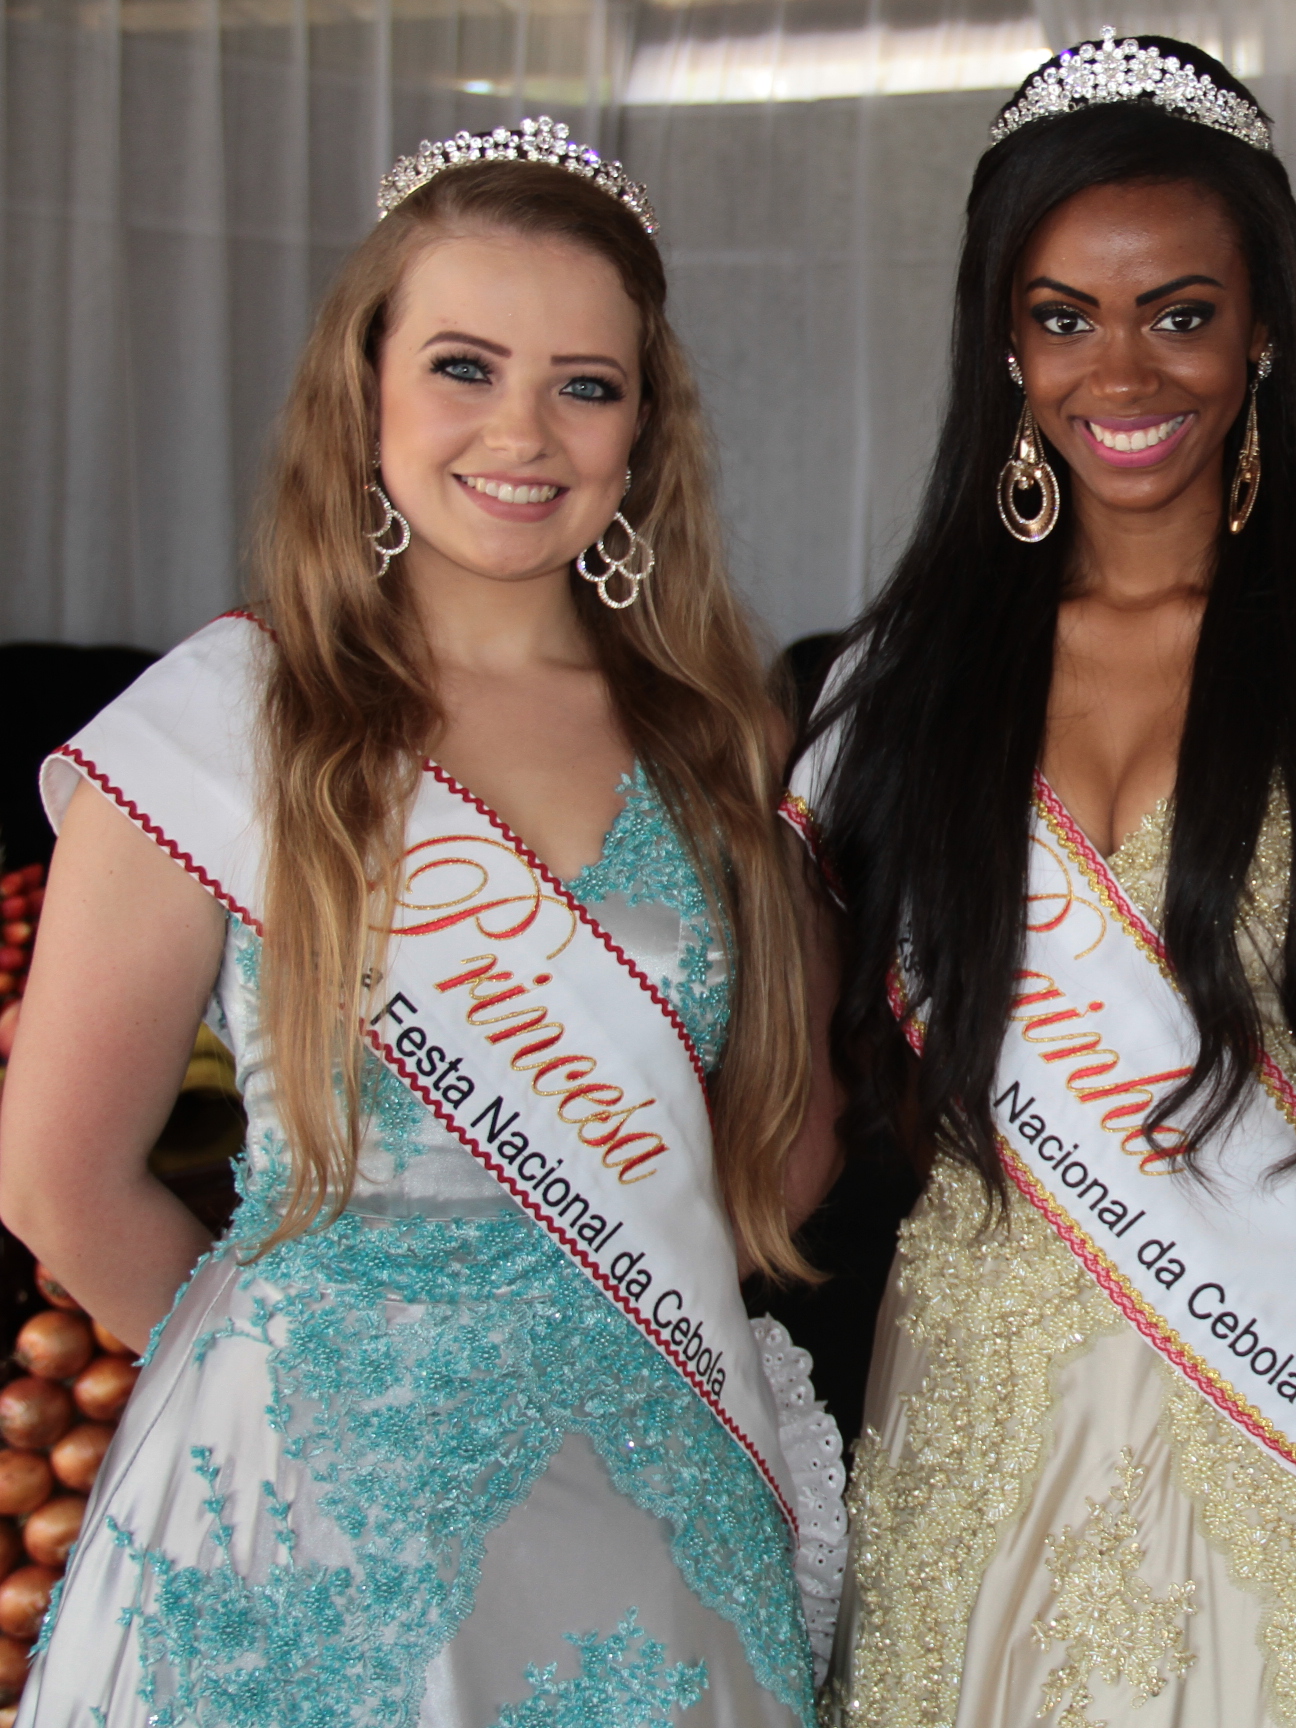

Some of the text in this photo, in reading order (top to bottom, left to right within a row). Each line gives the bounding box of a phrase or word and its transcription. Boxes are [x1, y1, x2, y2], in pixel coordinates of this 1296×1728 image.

[366, 834, 669, 1185] Princesa
[369, 991, 727, 1400] Festa Nacional da Cebola
[992, 1080, 1147, 1239] Nacional
[1137, 1238, 1187, 1291] da
